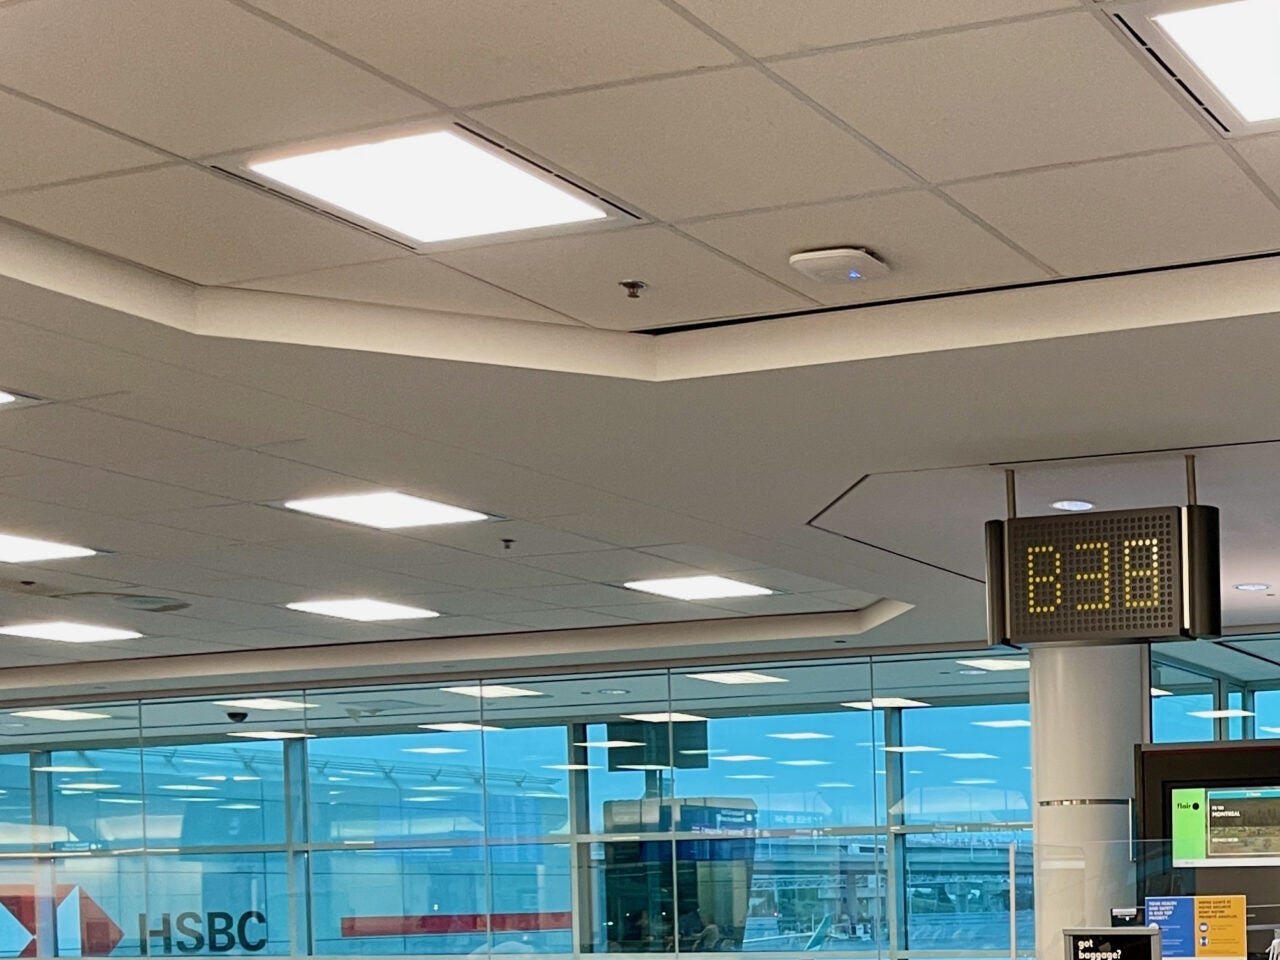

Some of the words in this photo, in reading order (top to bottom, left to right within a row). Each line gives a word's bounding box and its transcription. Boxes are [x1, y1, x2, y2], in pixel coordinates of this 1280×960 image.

[1027, 537, 1159, 613] B38
[138, 910, 267, 955] HSBC
[1078, 939, 1094, 950] got
[1078, 949, 1121, 960] baggage?
